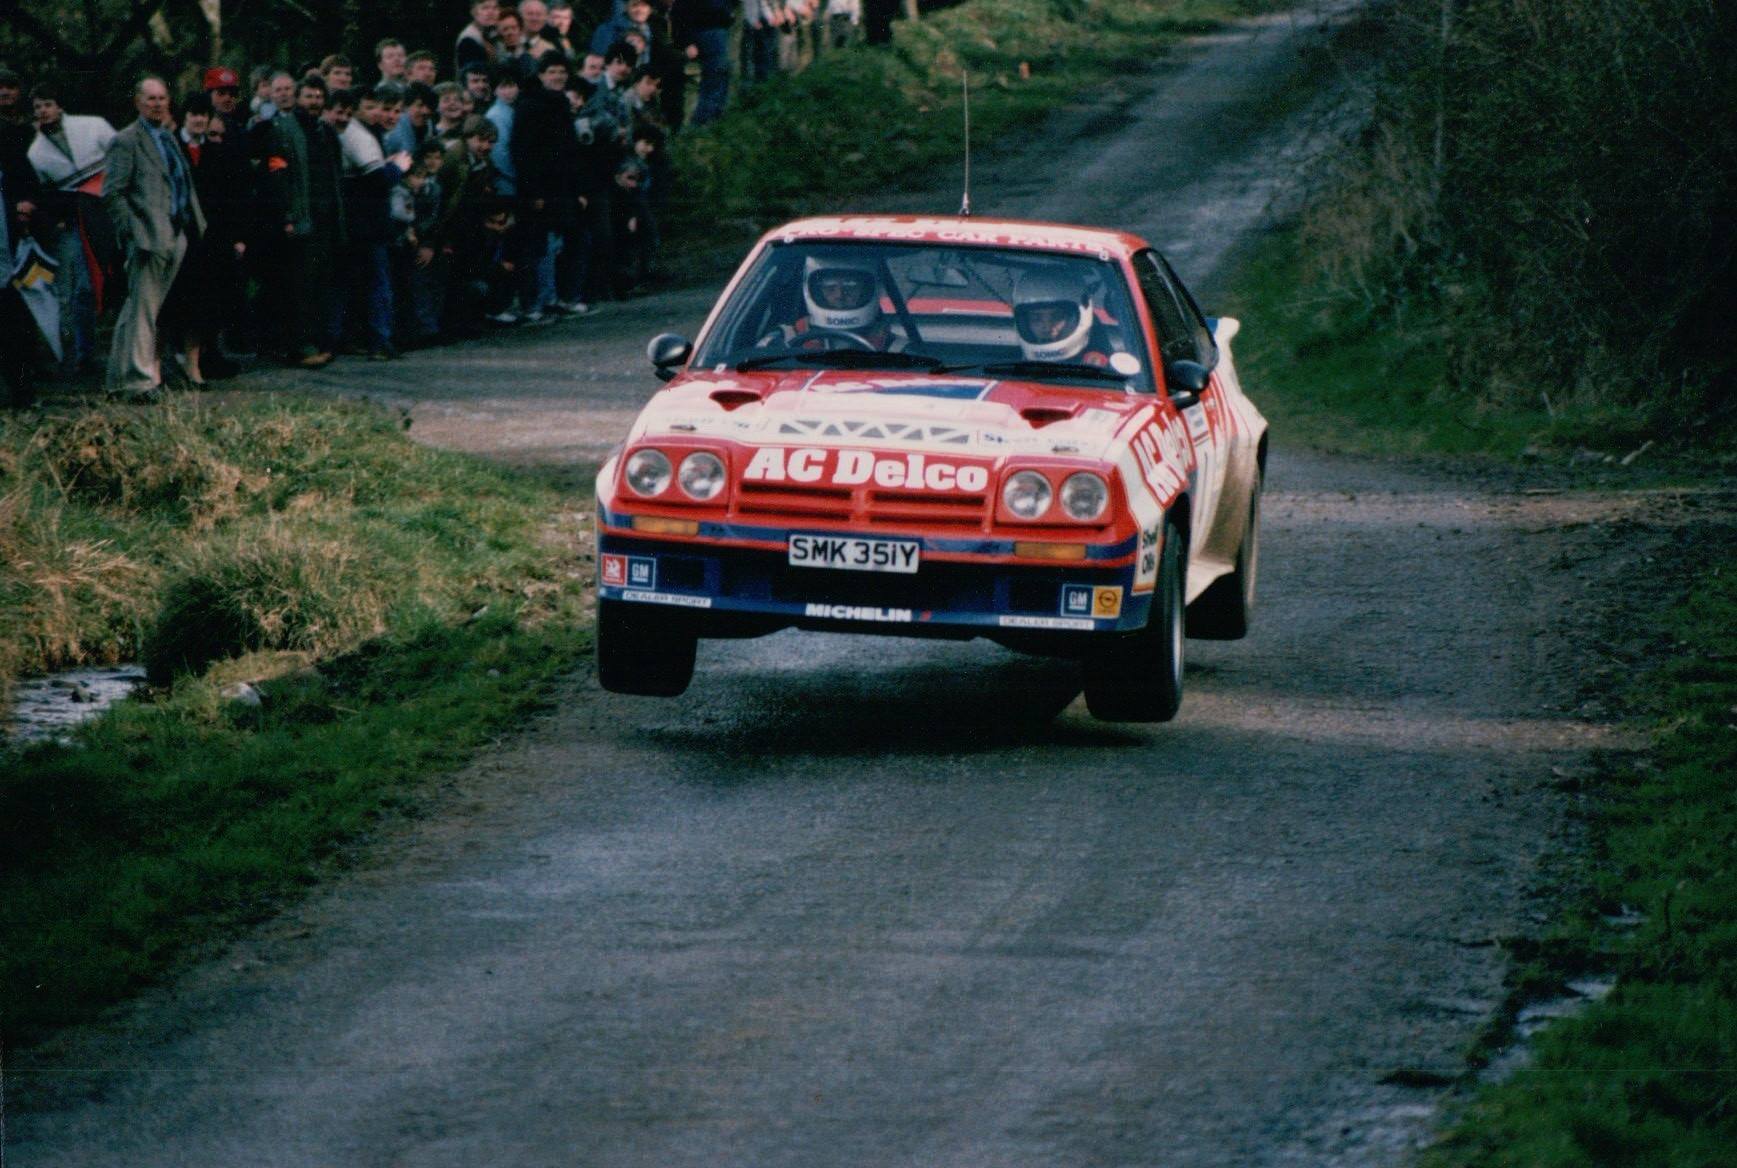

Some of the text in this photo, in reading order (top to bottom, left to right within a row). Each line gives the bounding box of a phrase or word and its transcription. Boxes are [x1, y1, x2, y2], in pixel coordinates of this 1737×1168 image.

[937, 229, 998, 243] CAR
[743, 447, 989, 493] AC Delco
[792, 537, 917, 568] SMK 351Y
[632, 562, 649, 578] GM
[1068, 591, 1088, 606] GM
[805, 602, 912, 622] MICHELIN
